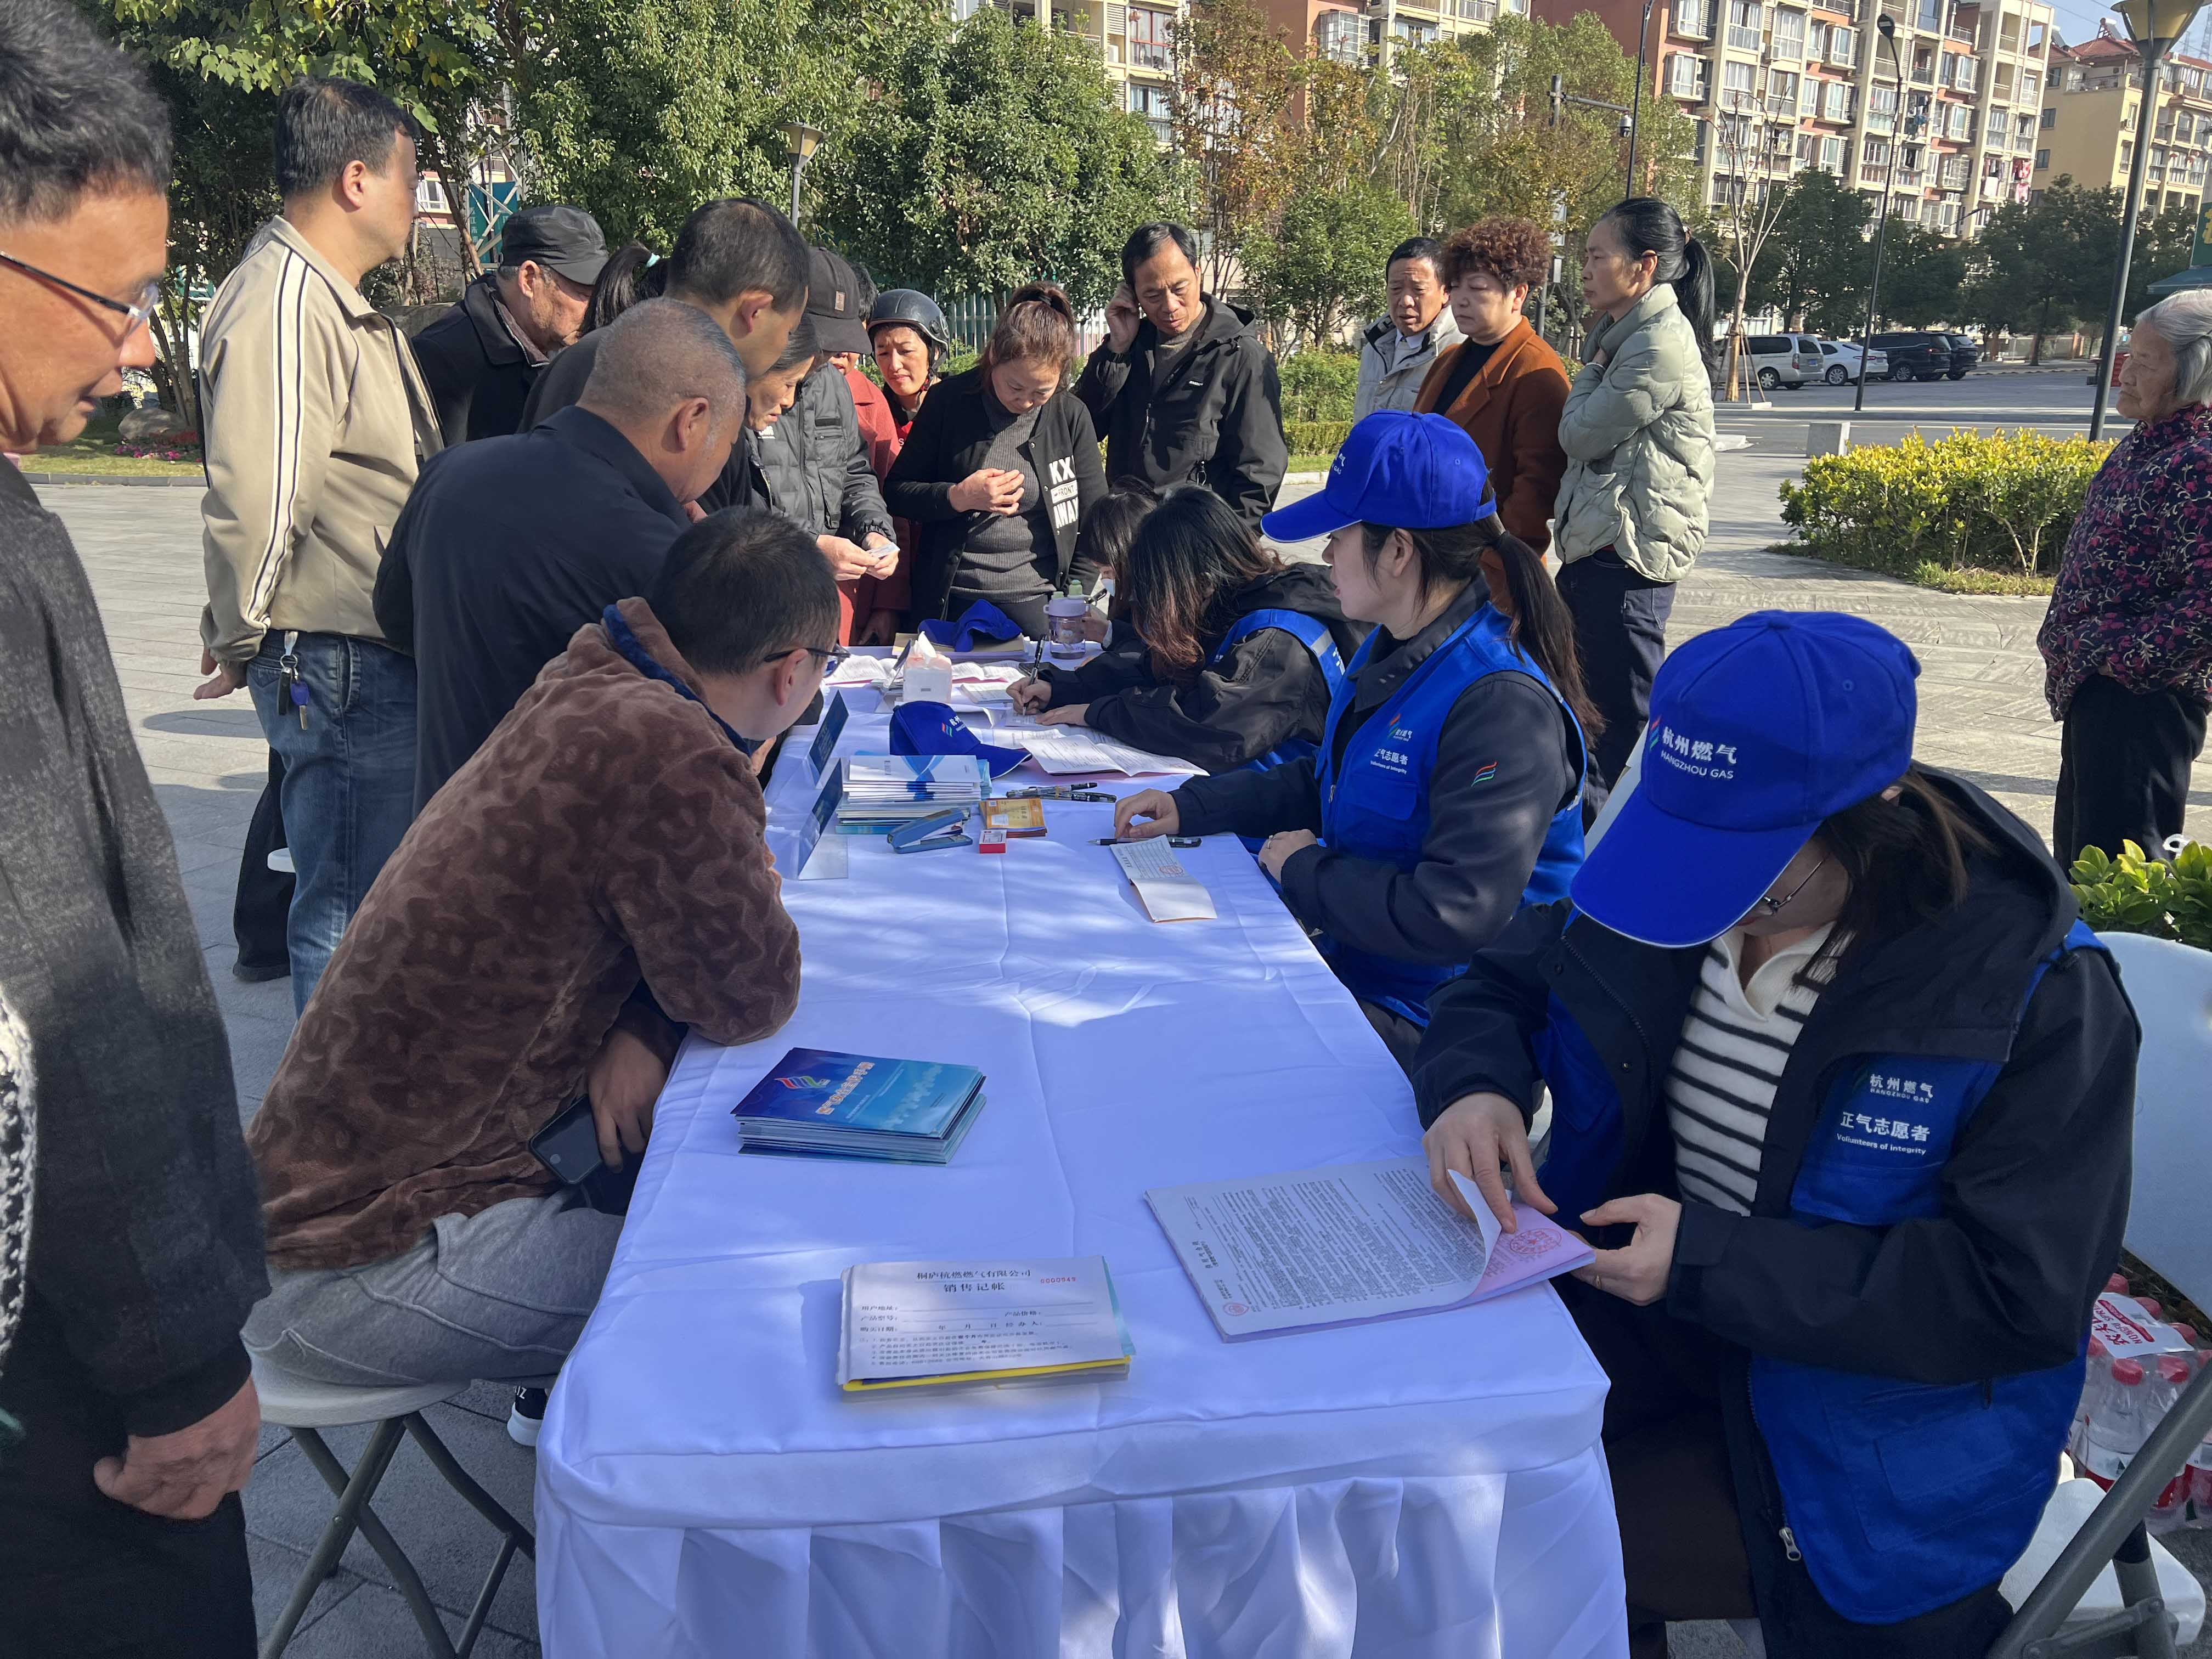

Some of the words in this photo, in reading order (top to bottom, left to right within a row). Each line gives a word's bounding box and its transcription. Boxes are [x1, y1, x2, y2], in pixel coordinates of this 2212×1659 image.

[1049, 455, 1076, 485] KX
[1058, 484, 1075, 496] FRONT
[1662, 726, 1737, 764] 杭州燃气
[1660, 750, 1707, 776] HANGZHOU
[1710, 769, 1734, 780] GAS
[1870, 1074, 1933, 1098] 杭州燃气
[1870, 1088, 1911, 1099] HANGZHOU
[1840, 1111, 1930, 1142] 正气志愿者
[1837, 1133, 1878, 1148] Volunteers
